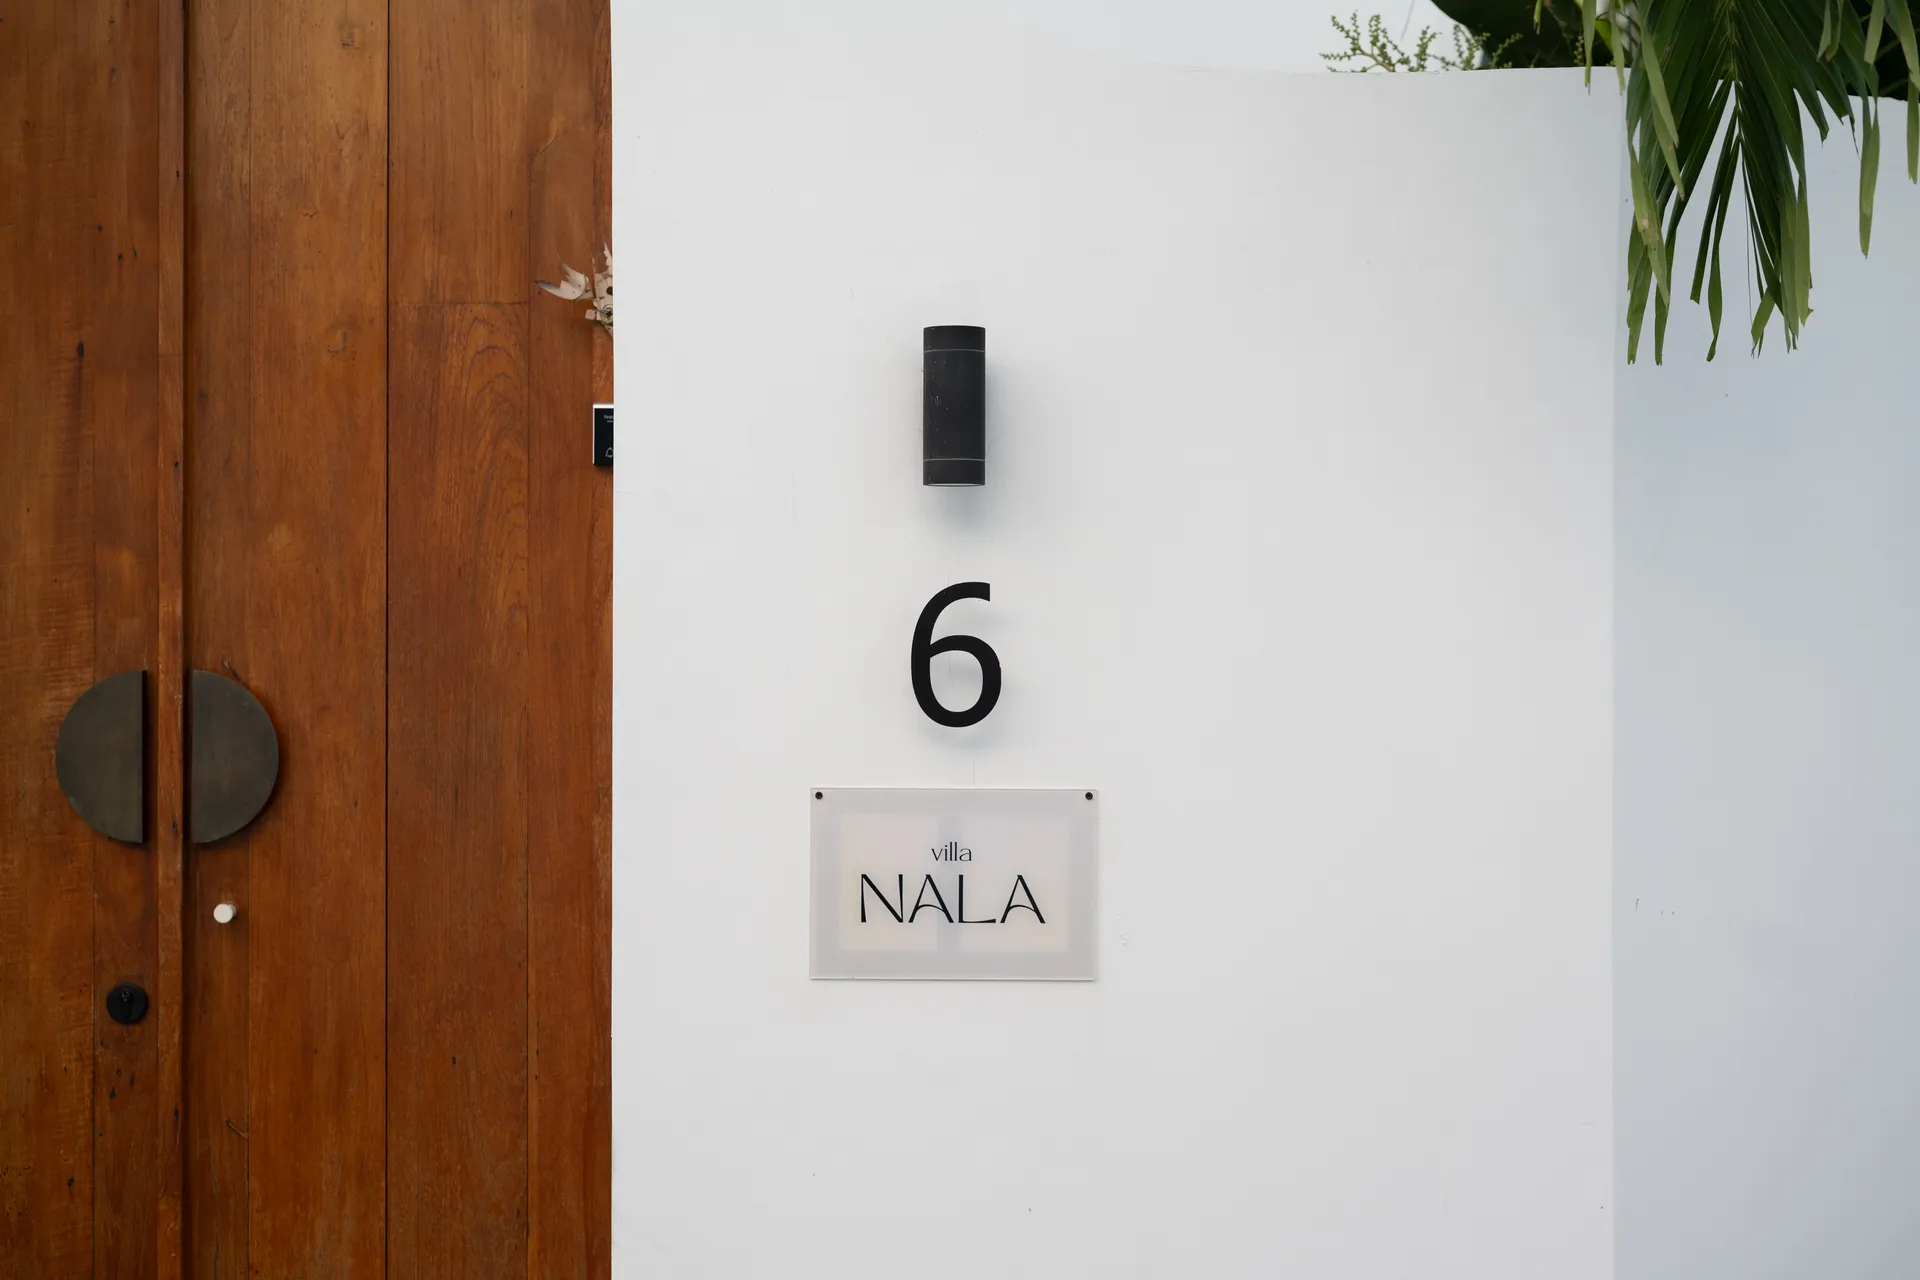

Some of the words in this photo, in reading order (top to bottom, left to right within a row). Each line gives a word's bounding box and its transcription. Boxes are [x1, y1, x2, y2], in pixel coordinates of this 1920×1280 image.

[910, 581, 1002, 728] 6
[930, 841, 972, 862] villa
[860, 873, 1046, 924] NALA
